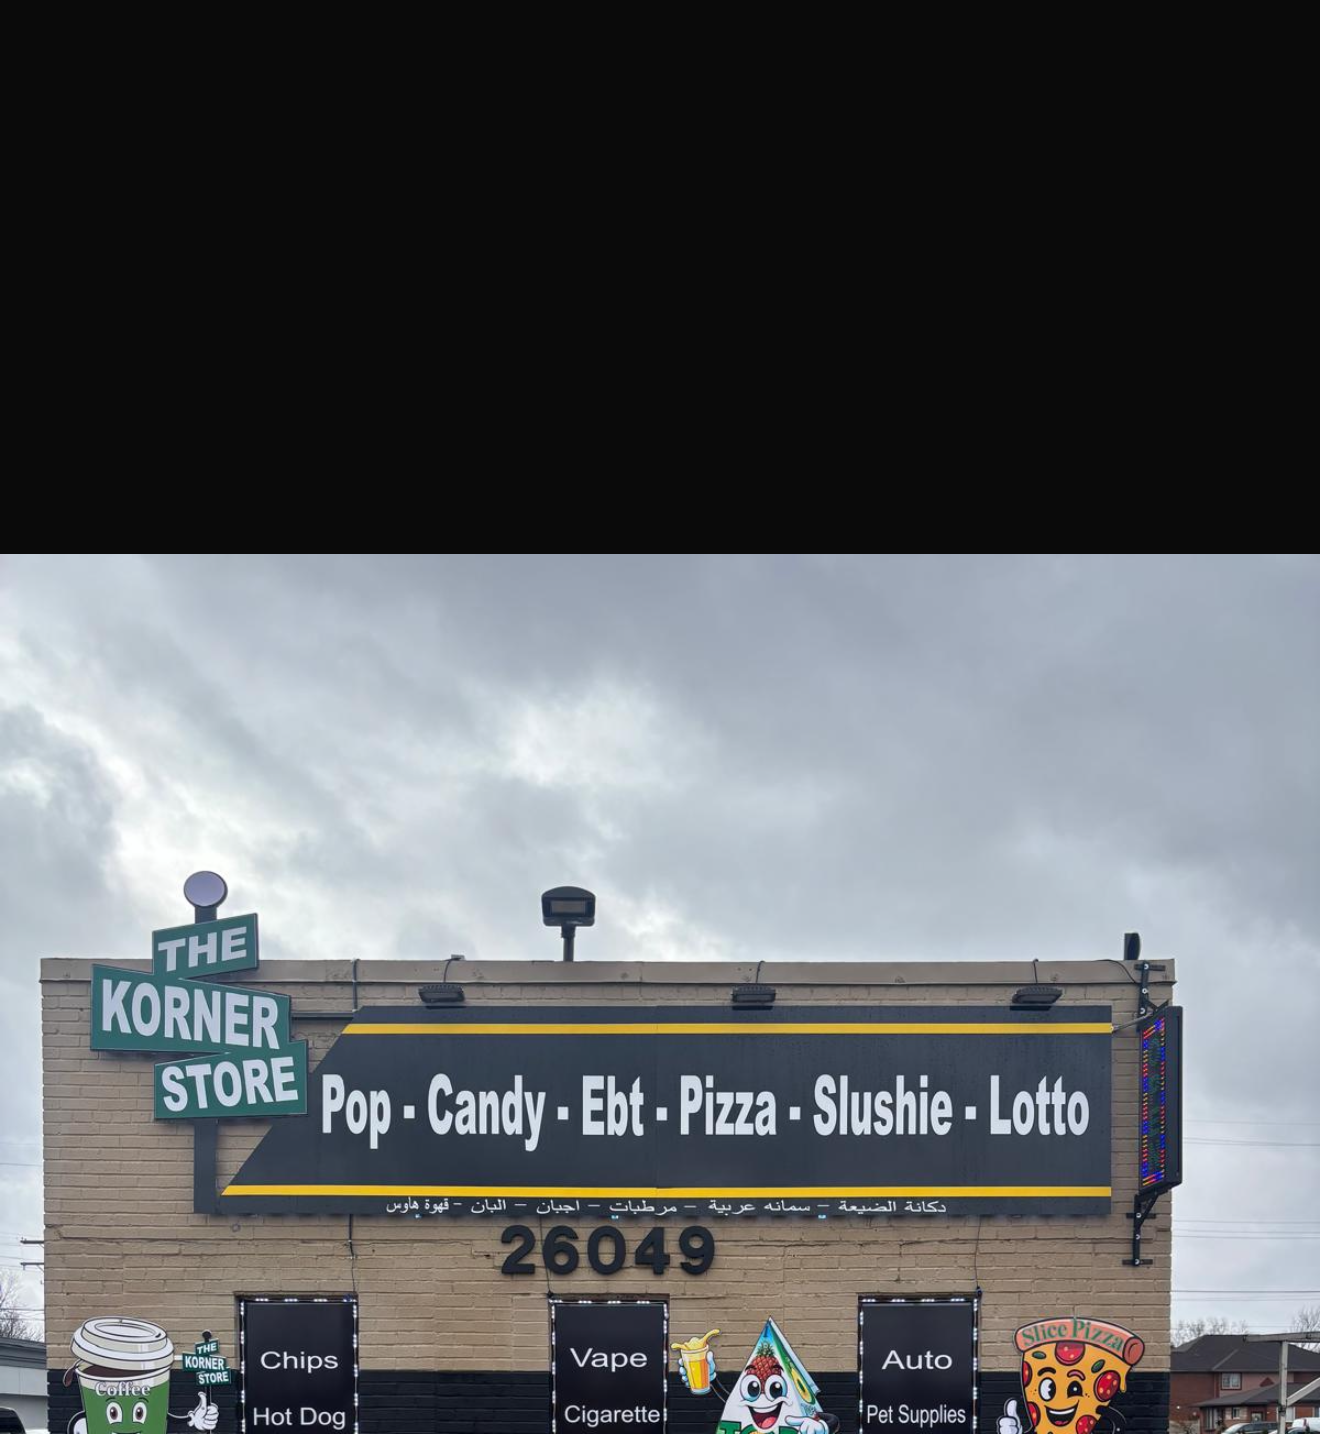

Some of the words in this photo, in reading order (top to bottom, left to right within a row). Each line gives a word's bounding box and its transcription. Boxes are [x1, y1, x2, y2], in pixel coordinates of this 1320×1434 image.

[157, 926, 247, 972] THE
[102, 978, 280, 1050] KORNER
[161, 1056, 299, 1112] STORE
[322, 1073, 392, 1150] Pop
[427, 1073, 547, 1152] Candy
[582, 1075, 644, 1137] Ebt
[680, 1074, 777, 1137] Pizza
[813, 1073, 953, 1136] Slushie
[990, 1074, 1090, 1136] Lotto
[609, 1199, 677, 1216] مرطبات
[708, 1199, 756, 1216] عربية
[838, 1200, 897, 1215] الضيعة
[904, 1200, 947, 1213] دكانة
[501, 1224, 715, 1276] 26049
[1021, 1323, 1068, 1347] Slice
[1070, 1317, 1123, 1351] Pizza
[196, 1342, 217, 1354] THE
[881, 1349, 953, 1370] Auto
[185, 1355, 225, 1370] KORNER
[260, 1351, 339, 1374] Chips
[570, 1347, 648, 1373] Vape
[95, 1381, 151, 1396] Coffee
[198, 1371, 229, 1385] STORE
[253, 1407, 293, 1426] Hot
[300, 1407, 346, 1430] Dog
[564, 1404, 660, 1428] Cigarette
[867, 1404, 894, 1424] Pet
[898, 1404, 966, 1428] Supplies
